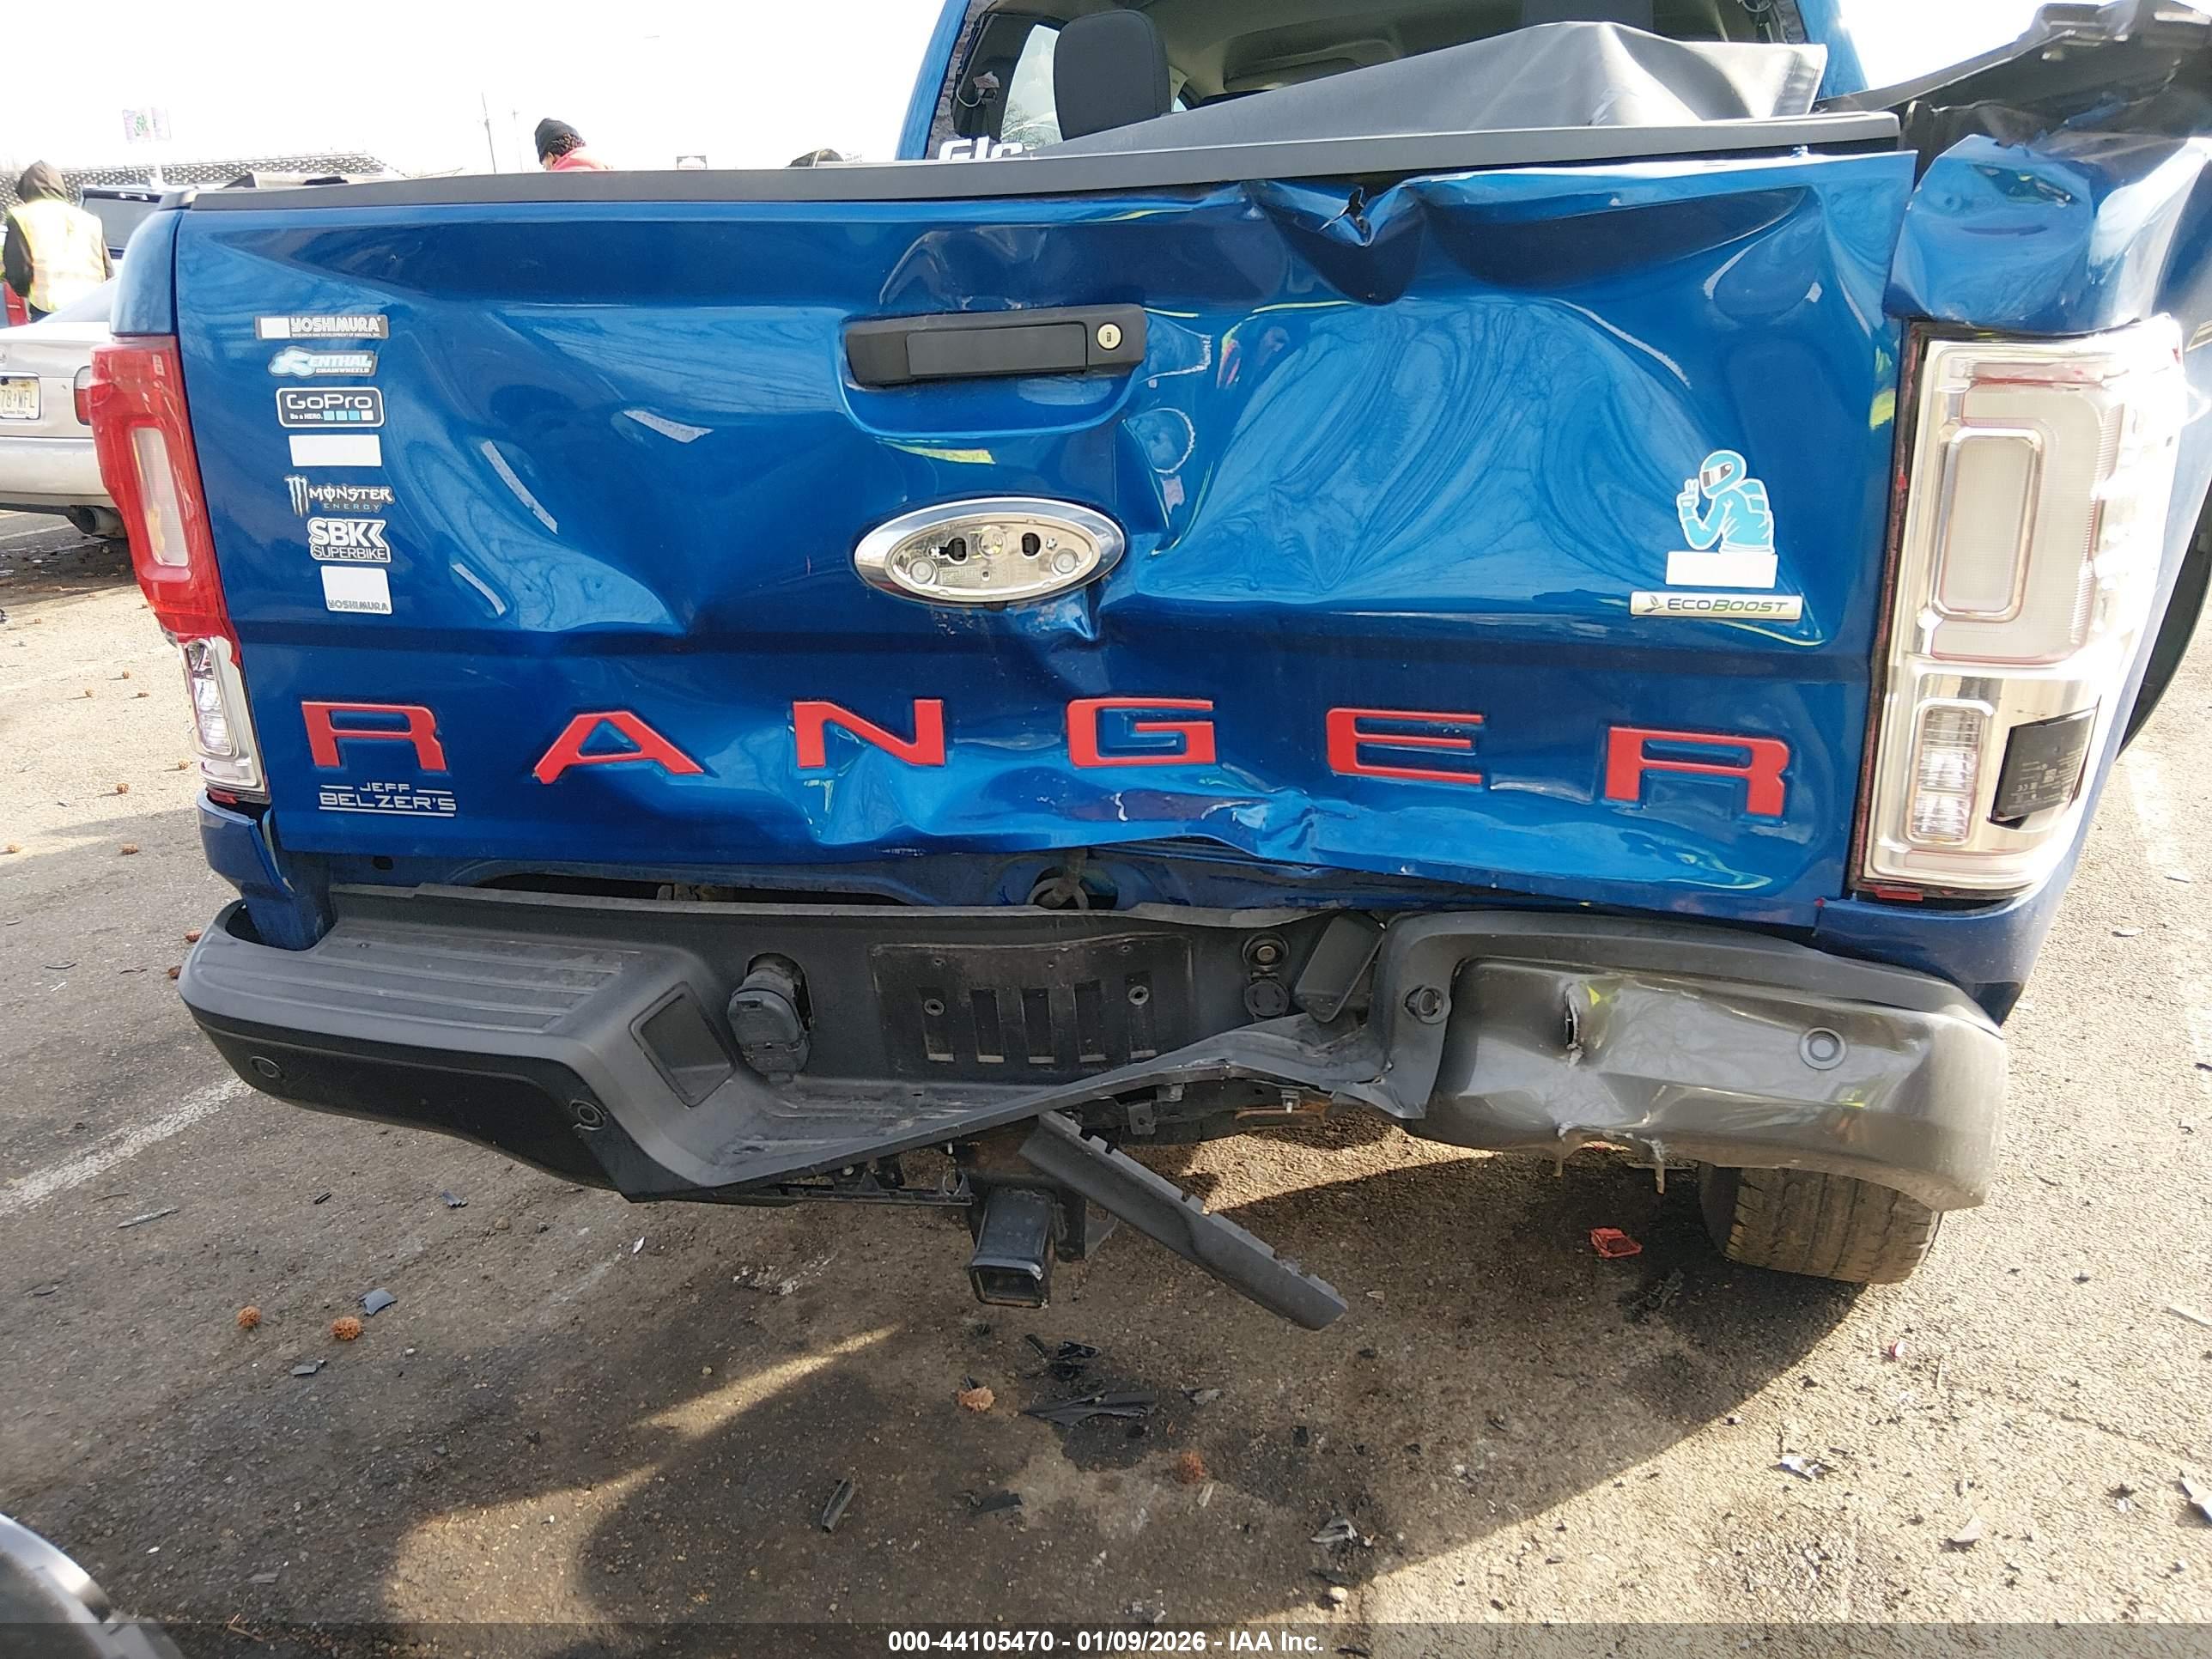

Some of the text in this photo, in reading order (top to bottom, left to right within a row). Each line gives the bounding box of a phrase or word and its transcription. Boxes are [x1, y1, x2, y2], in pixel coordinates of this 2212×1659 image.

[290, 317, 380, 332] YOSHIMURA
[286, 393, 373, 409] GoPro
[309, 486, 393, 502] MONSTER
[313, 545, 387, 560] SUPERBIKE
[327, 599, 389, 611] YOSHIMURA
[301, 698, 1791, 818] RANGER
[359, 782, 410, 793] JEFF
[319, 792, 457, 811] BELZER'S
